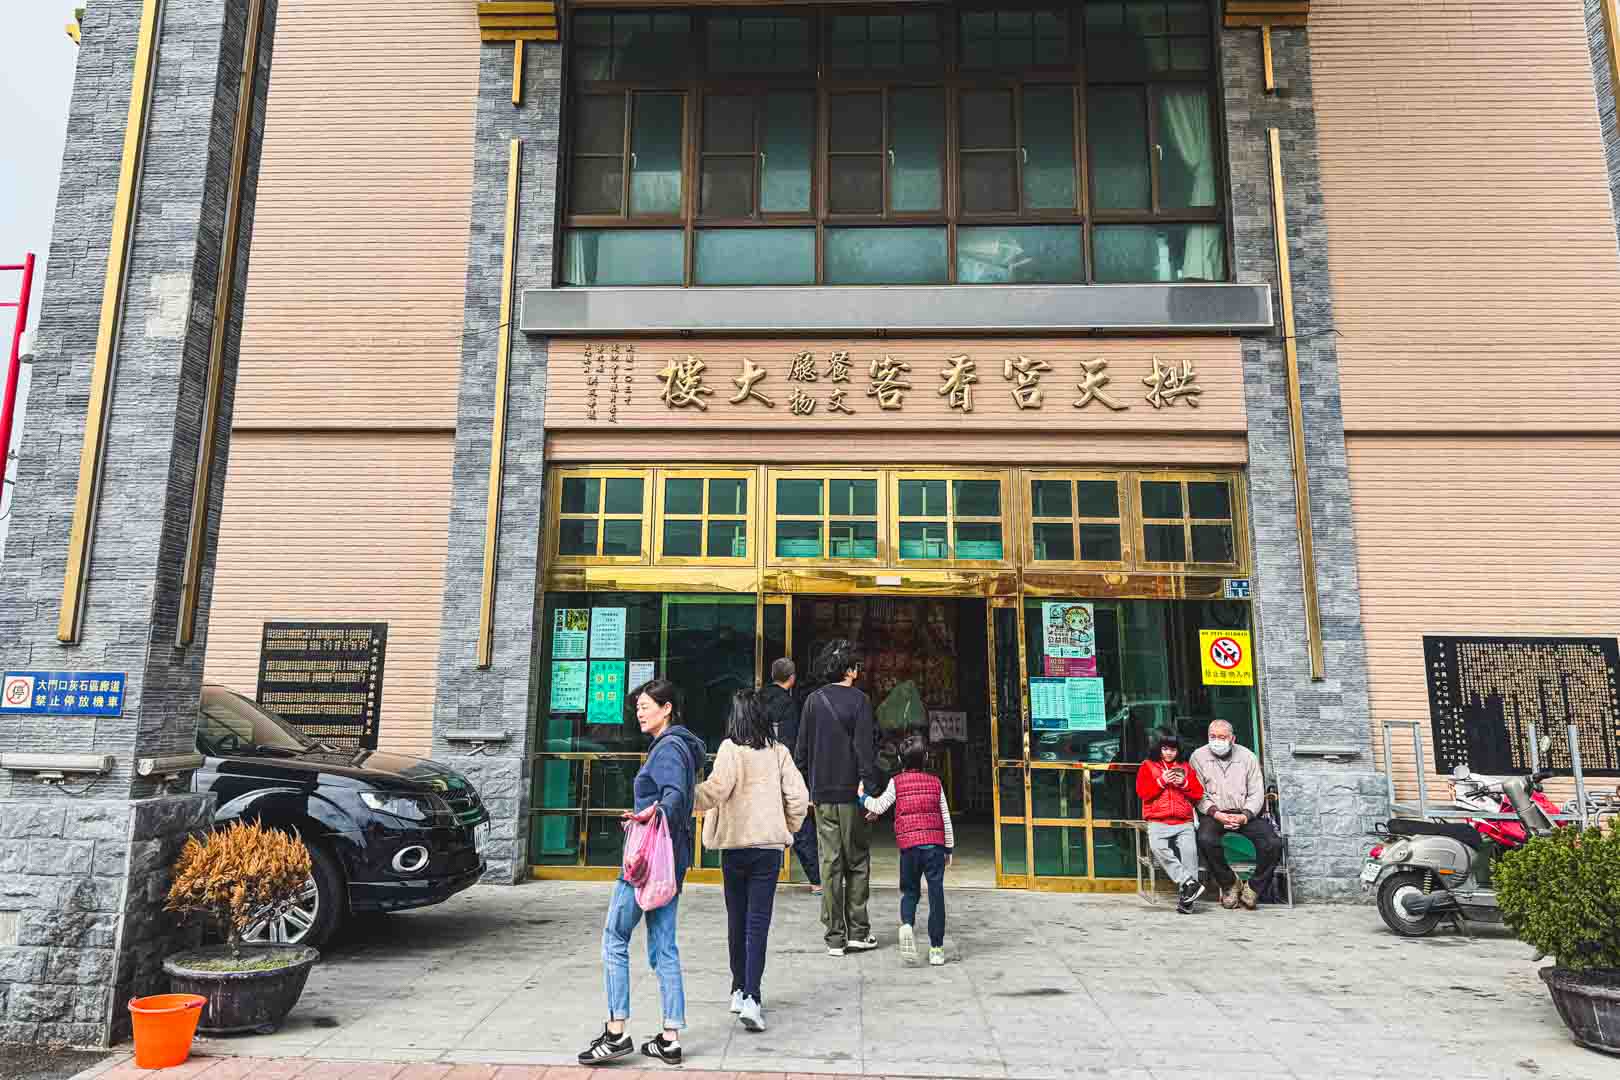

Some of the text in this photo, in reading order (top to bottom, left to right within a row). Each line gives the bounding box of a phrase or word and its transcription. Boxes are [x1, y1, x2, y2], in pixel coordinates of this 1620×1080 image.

[35, 694, 119, 708] 禁止停放機車
